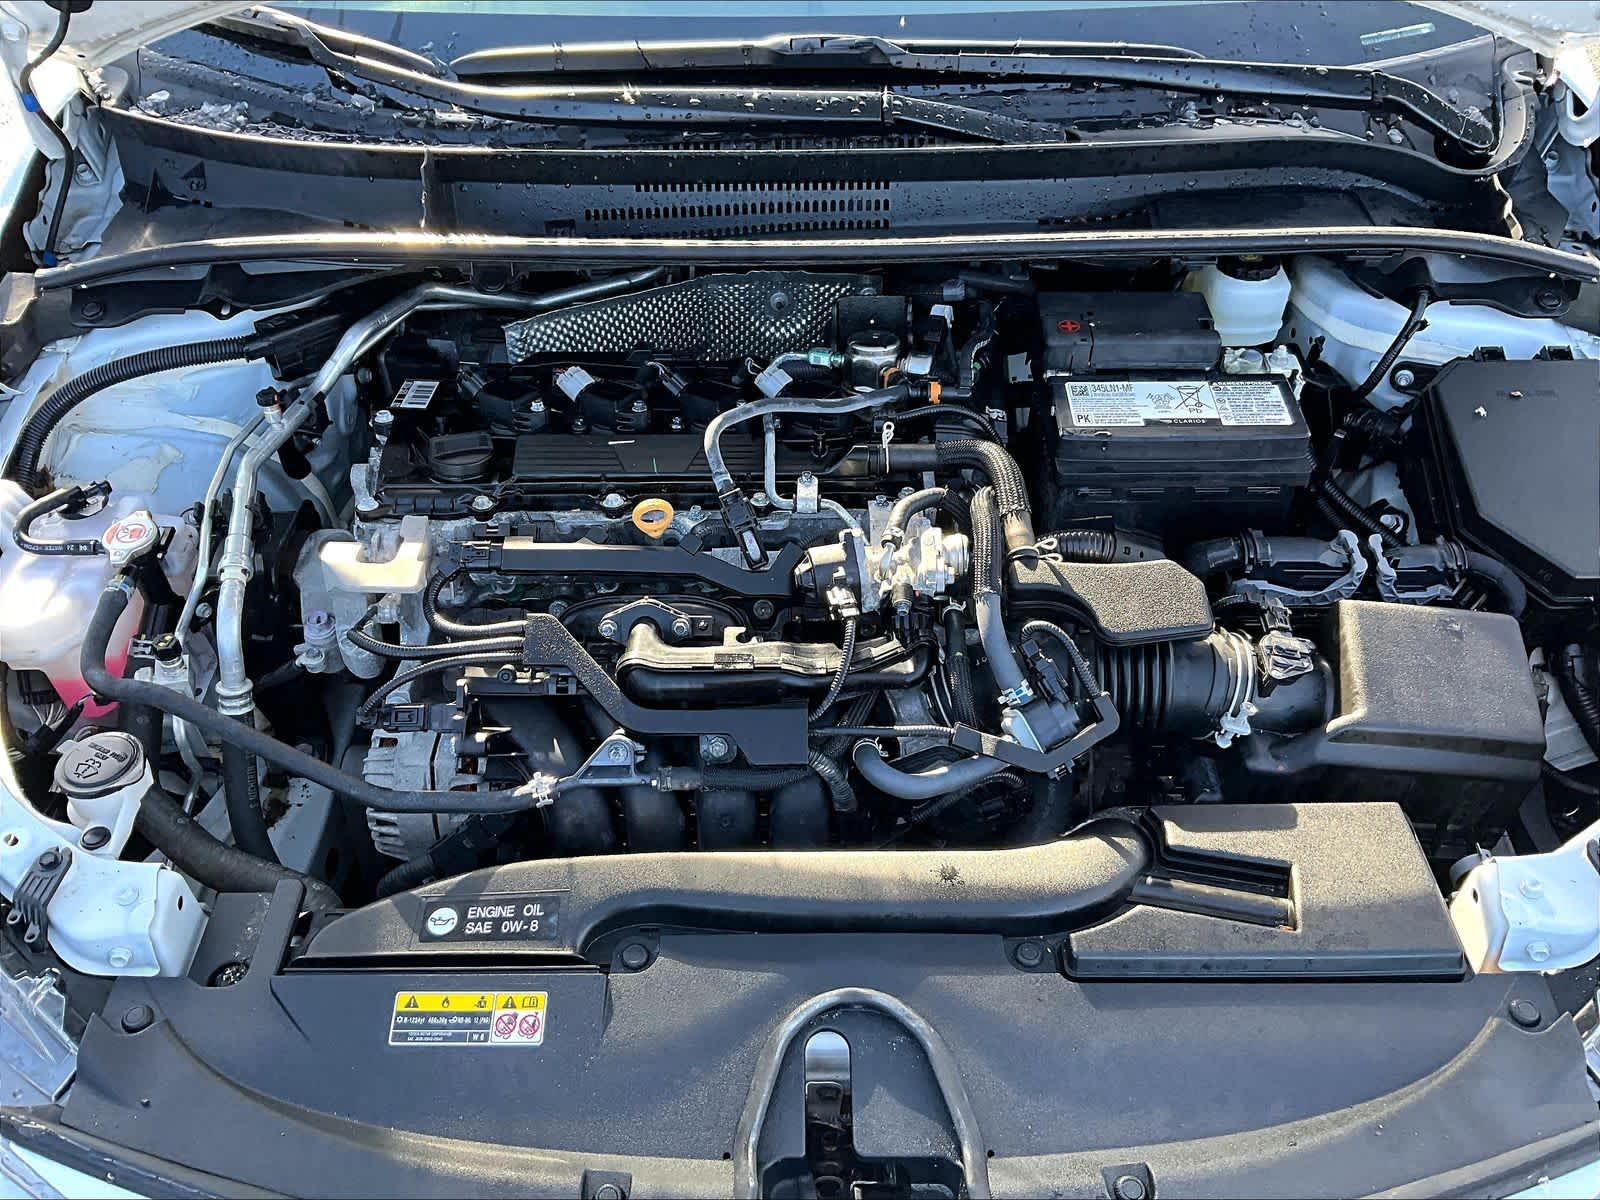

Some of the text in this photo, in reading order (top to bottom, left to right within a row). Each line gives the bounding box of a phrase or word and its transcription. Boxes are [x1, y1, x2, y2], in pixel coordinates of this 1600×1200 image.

[1091, 383, 1134, 392] 345LN1-MF
[1077, 414, 1091, 423] PK
[467, 903, 545, 919] ENGINE OIL
[464, 919, 539, 934] SAE 0W-8
